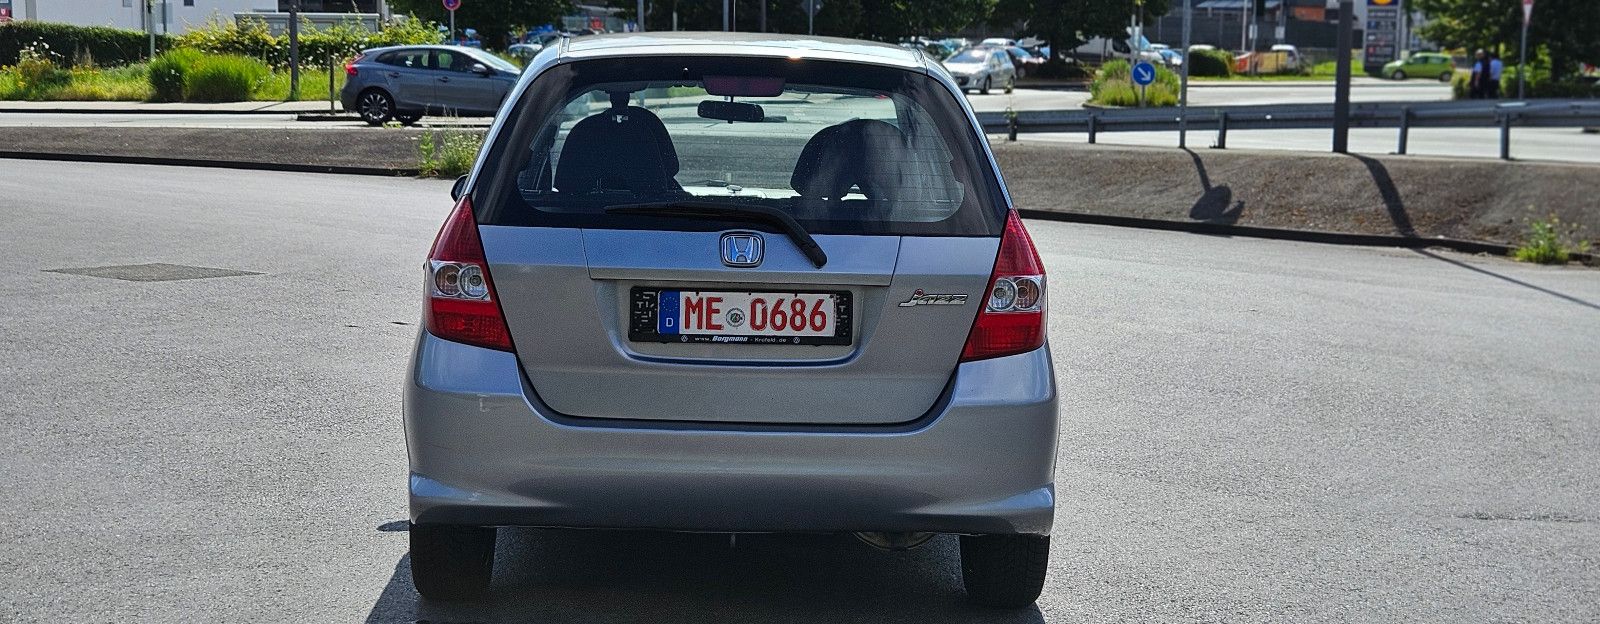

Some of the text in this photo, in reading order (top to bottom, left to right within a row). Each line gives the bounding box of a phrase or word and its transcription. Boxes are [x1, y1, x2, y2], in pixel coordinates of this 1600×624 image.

[666, 317, 674, 328] D
[685, 296, 827, 332] ME 0686
